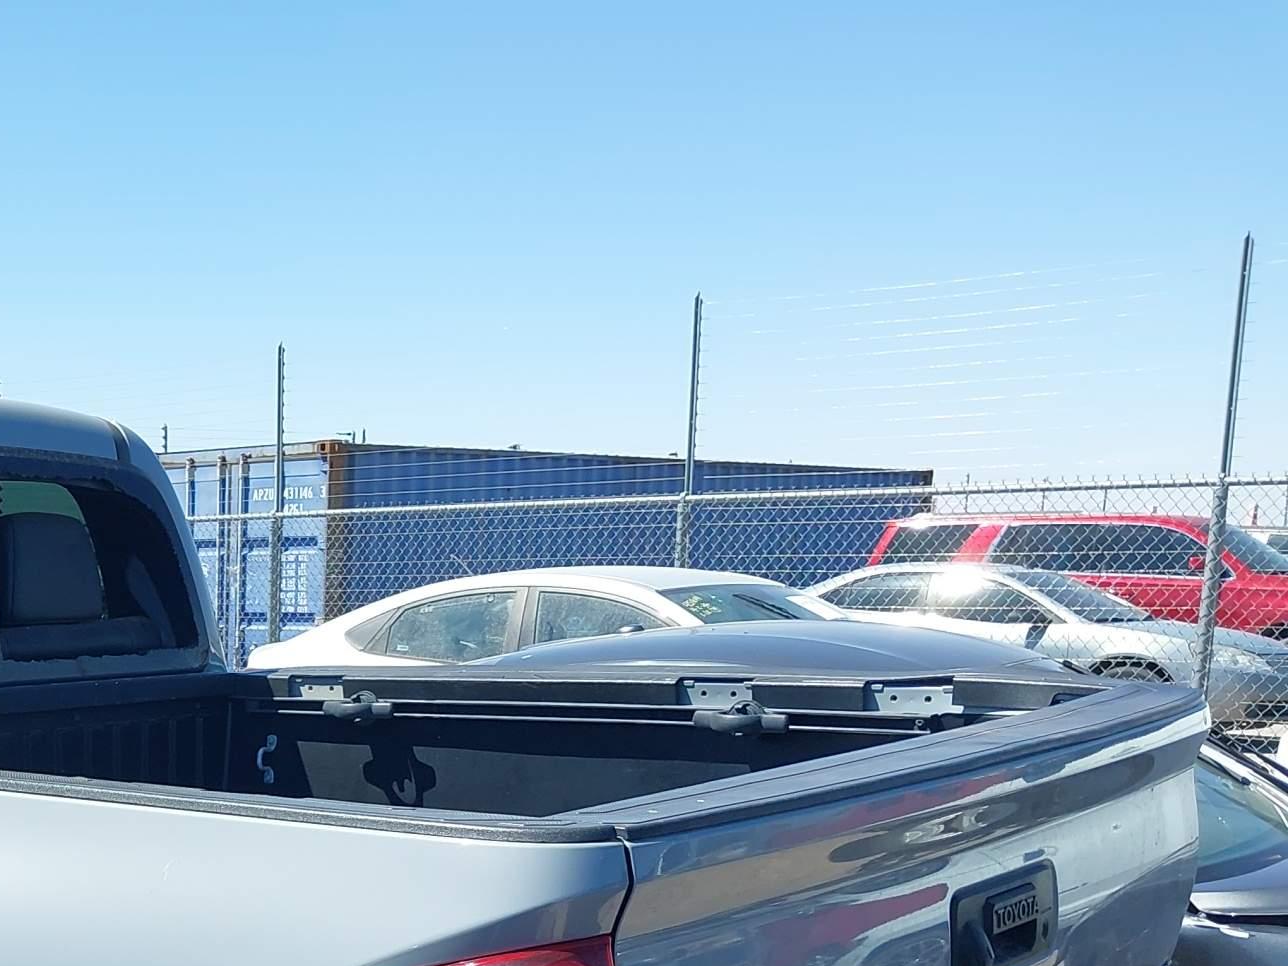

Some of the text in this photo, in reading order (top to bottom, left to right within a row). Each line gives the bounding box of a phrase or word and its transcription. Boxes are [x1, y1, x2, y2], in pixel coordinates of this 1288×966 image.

[253, 485, 326, 500] APZU 431146 3
[993, 895, 1040, 930] TOYOTA
